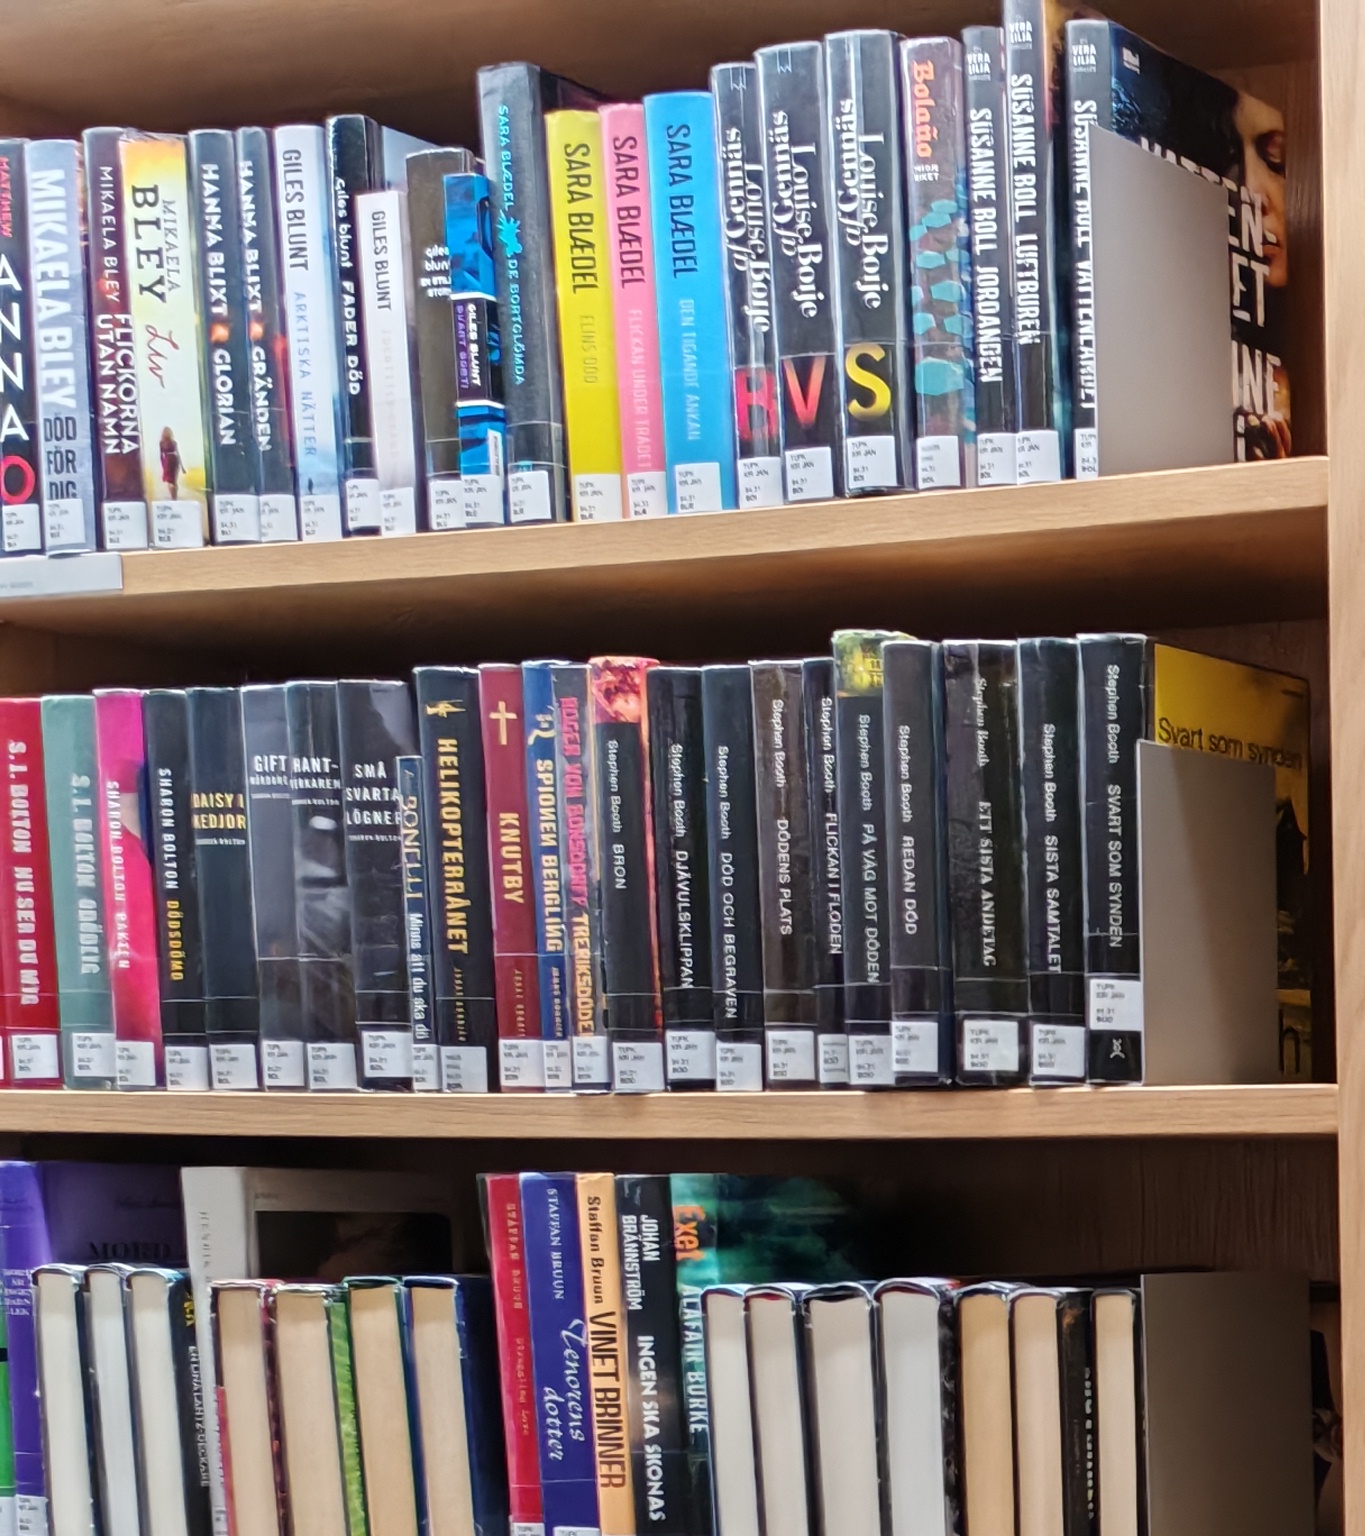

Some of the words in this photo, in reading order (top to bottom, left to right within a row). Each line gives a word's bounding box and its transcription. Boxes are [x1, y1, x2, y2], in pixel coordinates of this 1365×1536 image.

[666, 123, 692, 184] SARA
[1011, 75, 1034, 170] SUSANNE
[201, 163, 223, 247] HANNA
[283, 149, 304, 205] GILES
[563, 143, 593, 204] SARA
[1015, 172, 1036, 221] BOLL
[100, 166, 118, 246] MIKAELA
[668, 192, 698, 279] BLÆDEL
[30, 168, 70, 319] MIKAELA
[131, 185, 167, 304] BLEY
[162, 200, 179, 293] MIKAELA
[287, 209, 310, 271] BLUNT
[568, 211, 599, 294] BLÆDEL
[104, 255, 121, 304] BLEY
[207, 253, 227, 317] BLIXT
[1015, 234, 1042, 346] LUFTBUREN
[96, 314, 116, 377] UTAN
[342, 281, 357, 346] FADER
[39, 321, 78, 410] BLEY
[114, 313, 139, 455] FLICKORNA
[347, 356, 361, 395] DÖD
[845, 343, 891, 421] S
[44, 417, 78, 442] DÖD
[102, 383, 120, 454] NAMN
[212, 350, 236, 446] GLORIAN
[46, 448, 78, 475] FÖR
[1107, 664, 1119, 719] Stephen
[354, 762, 387, 779] SMÅ
[1043, 724, 1055, 778] Stephen
[1108, 723, 1120, 764] Booth
[159, 768, 174, 827] SHARON
[193, 792, 231, 811] DAISY
[238, 796, 244, 809] I
[193, 812, 246, 830] KEDJOR
[536, 760, 558, 850] SPIONEN
[1044, 780, 1056, 821] Booth
[1108, 784, 1121, 834] SVART
[163, 832, 179, 889] BOLTON
[437, 738, 469, 954] HELIKOPTERRÅNET
[499, 812, 524, 905] KNUTBY
[721, 853, 733, 888] DÖD
[1045, 836, 1059, 883] SISTA
[1108, 836, 1121, 873] SOM
[539, 853, 564, 953] BERGLING
[723, 893, 734, 925] OCH
[1046, 886, 1061, 975] SAMTALET
[1108, 877, 1122, 948] SYNDEN
[166, 898, 184, 982] DÖDSDÖMD
[723, 929, 737, 1019] BEGRAVEN
[622, 1215, 641, 1310] BRÄNNSTRÖM
[639, 1215, 658, 1262] JOHAN
[590, 1310, 618, 1382] VINET
[637, 1335, 658, 1396] INGEN
[593, 1386, 626, 1488] BRINNER
[643, 1400, 661, 1440] SKA
[644, 1444, 666, 1524] SKONAS
